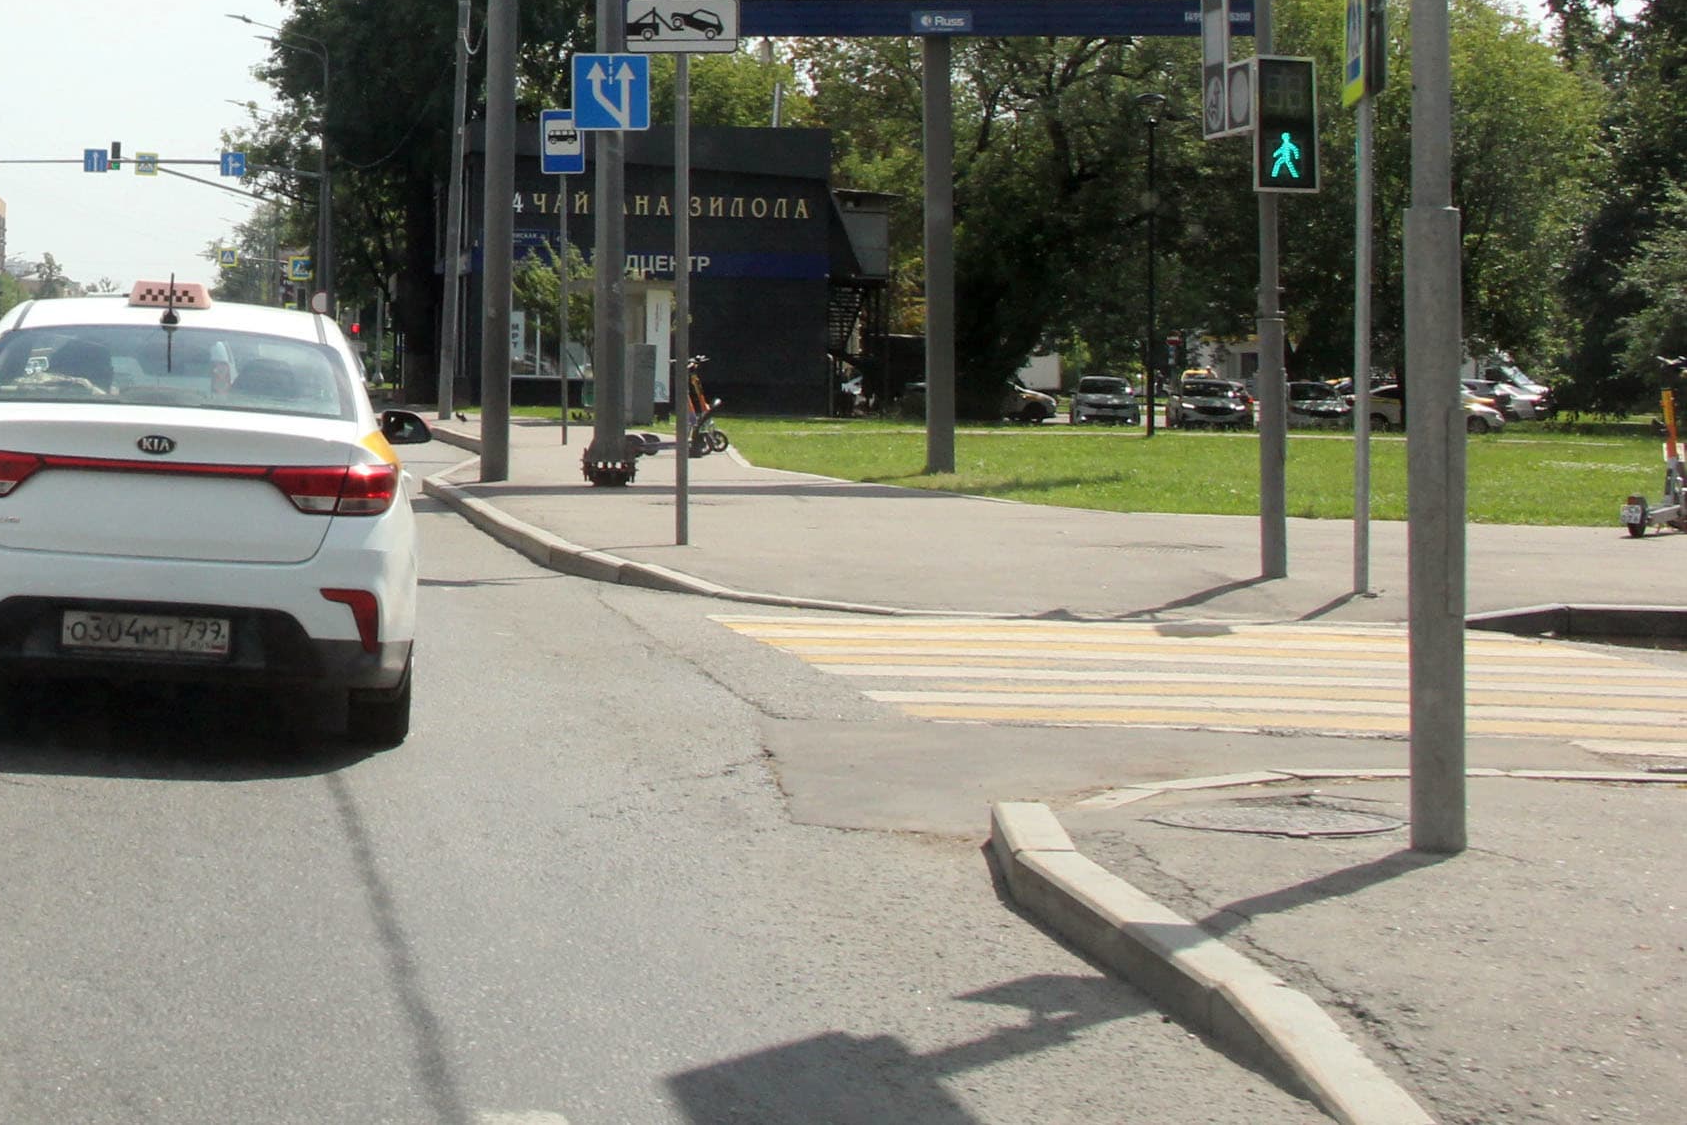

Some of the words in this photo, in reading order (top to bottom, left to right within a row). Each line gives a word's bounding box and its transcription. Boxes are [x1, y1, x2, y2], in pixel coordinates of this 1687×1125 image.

[689, 196, 809, 220] ЗИЛОЛА
[141, 438, 170, 451] KIA
[70, 617, 173, 645] О304МТ
[184, 619, 222, 641] 799
